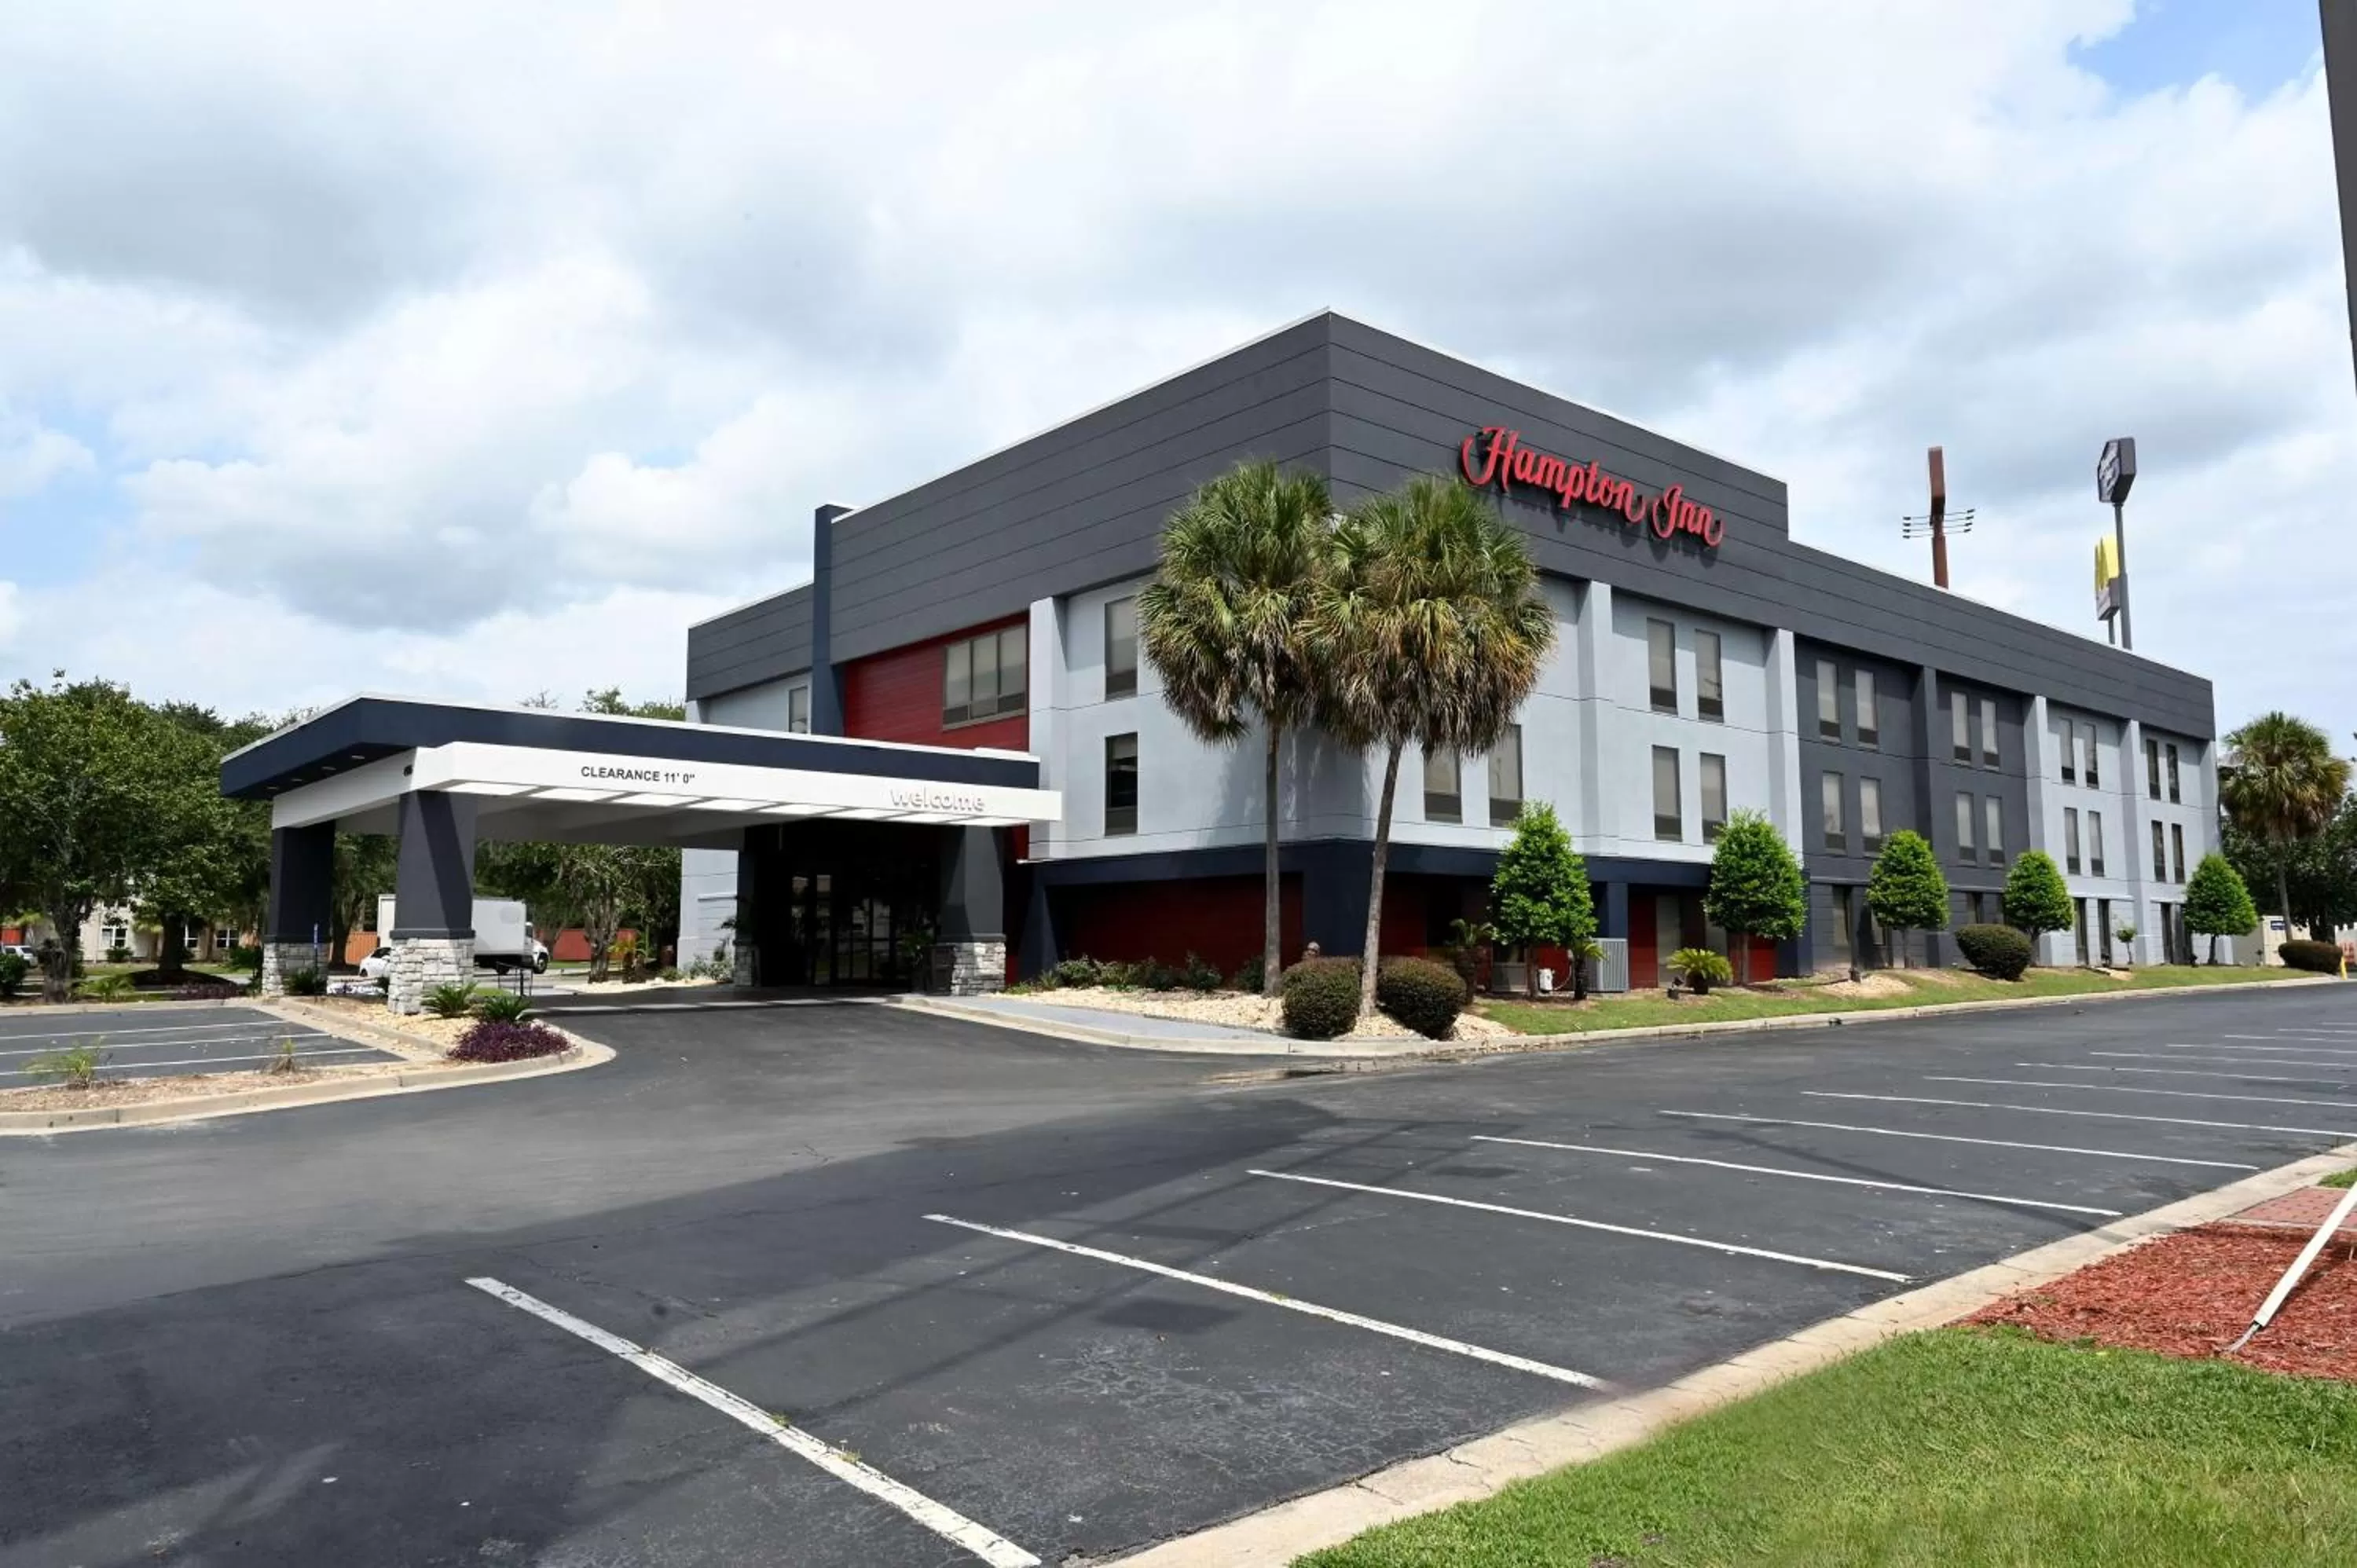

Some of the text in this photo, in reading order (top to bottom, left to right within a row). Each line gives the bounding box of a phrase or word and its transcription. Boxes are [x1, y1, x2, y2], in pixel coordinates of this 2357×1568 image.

[1461, 426, 1725, 547] Hampton Inn
[581, 766, 661, 782] CLEARANCE
[664, 772, 680, 783] 11'
[889, 786, 984, 811] welcome
